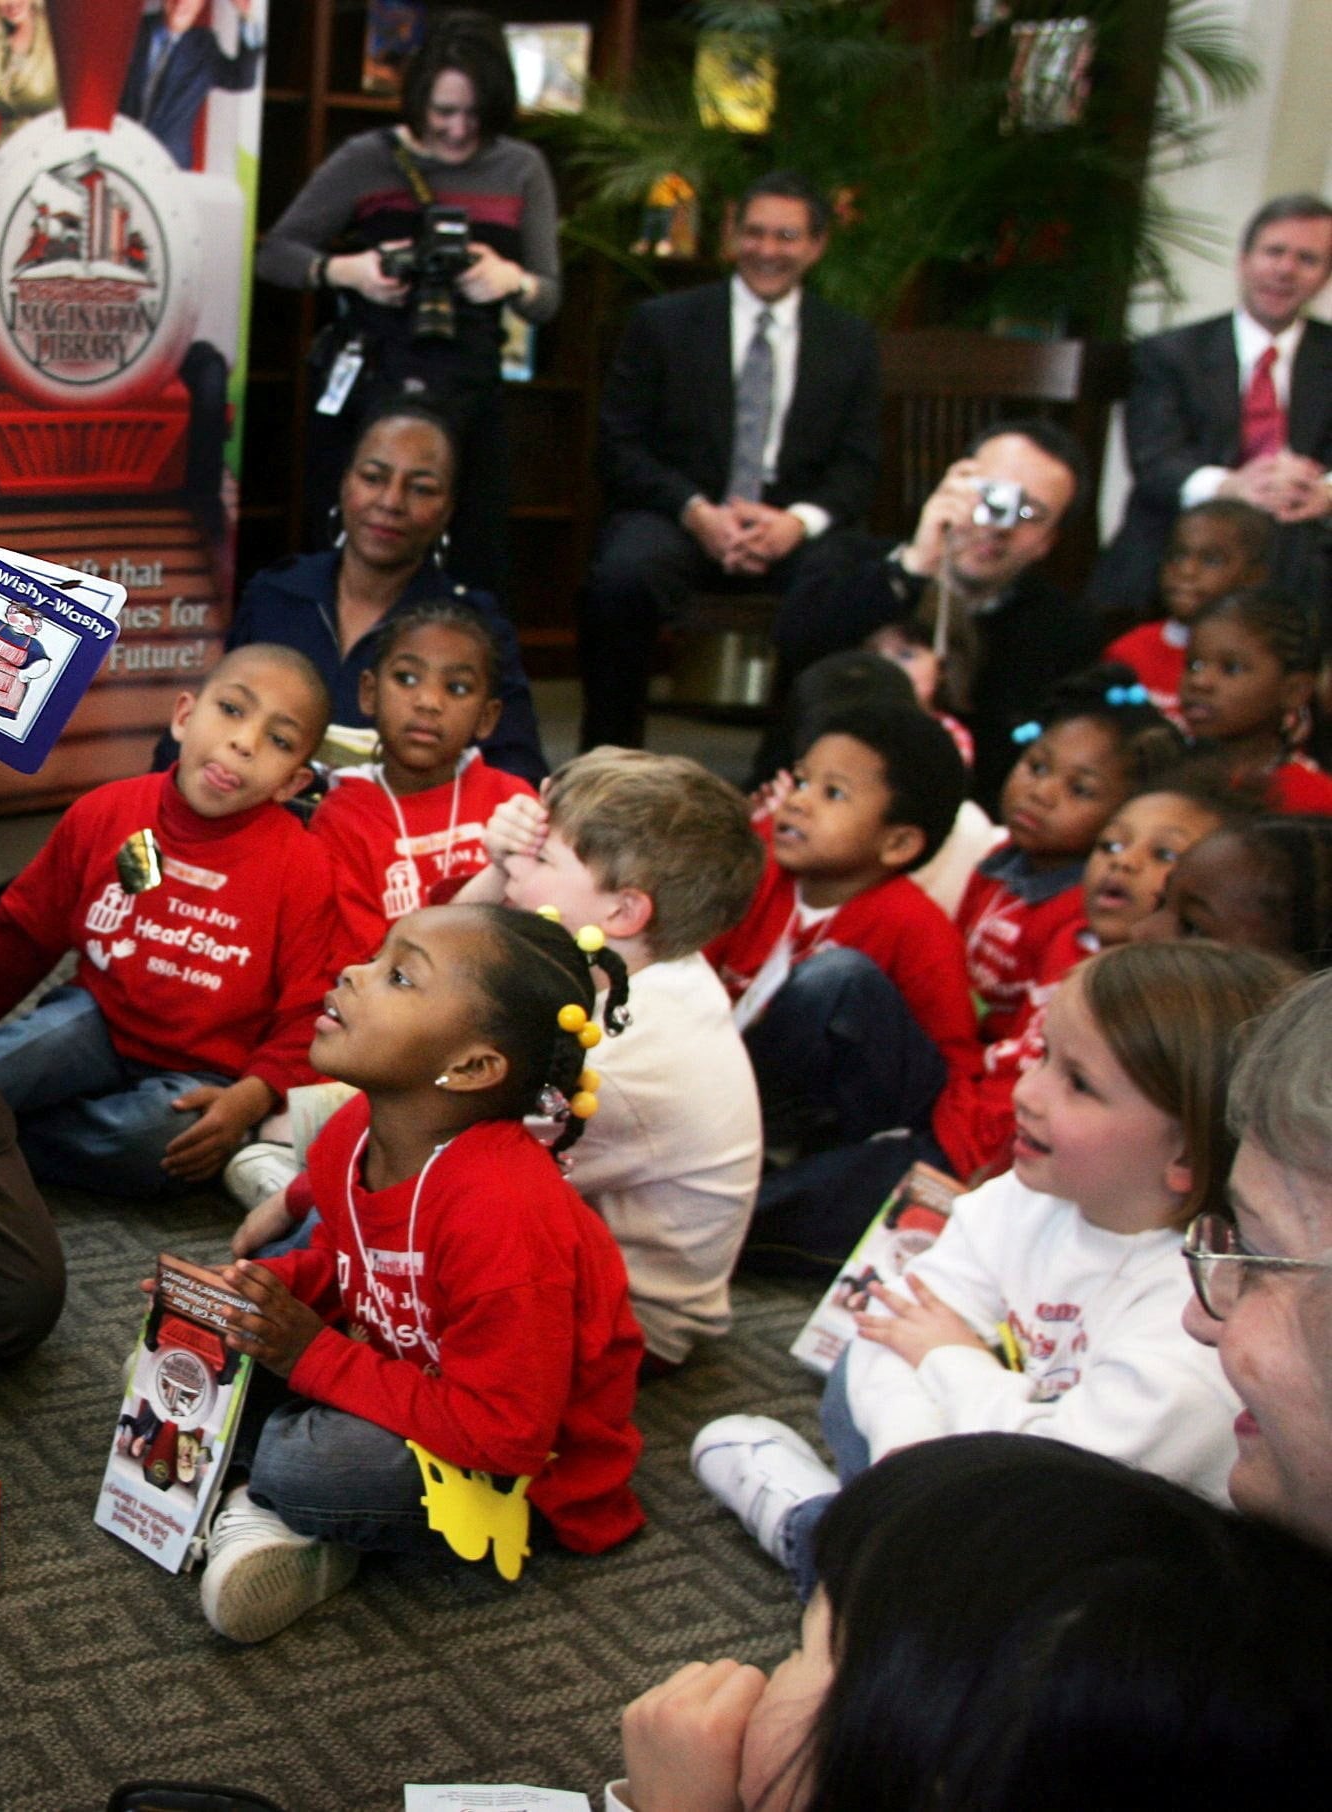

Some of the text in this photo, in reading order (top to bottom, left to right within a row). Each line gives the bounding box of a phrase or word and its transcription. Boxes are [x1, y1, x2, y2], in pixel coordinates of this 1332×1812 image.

[9, 291, 157, 332] IMAGINATION
[34, 332, 127, 371] LIBRARY
[109, 557, 163, 588] that
[170, 597, 209, 628] for
[109, 638, 206, 673] Future!
[134, 915, 251, 967] Head Start
[146, 955, 223, 991] 880-1690
